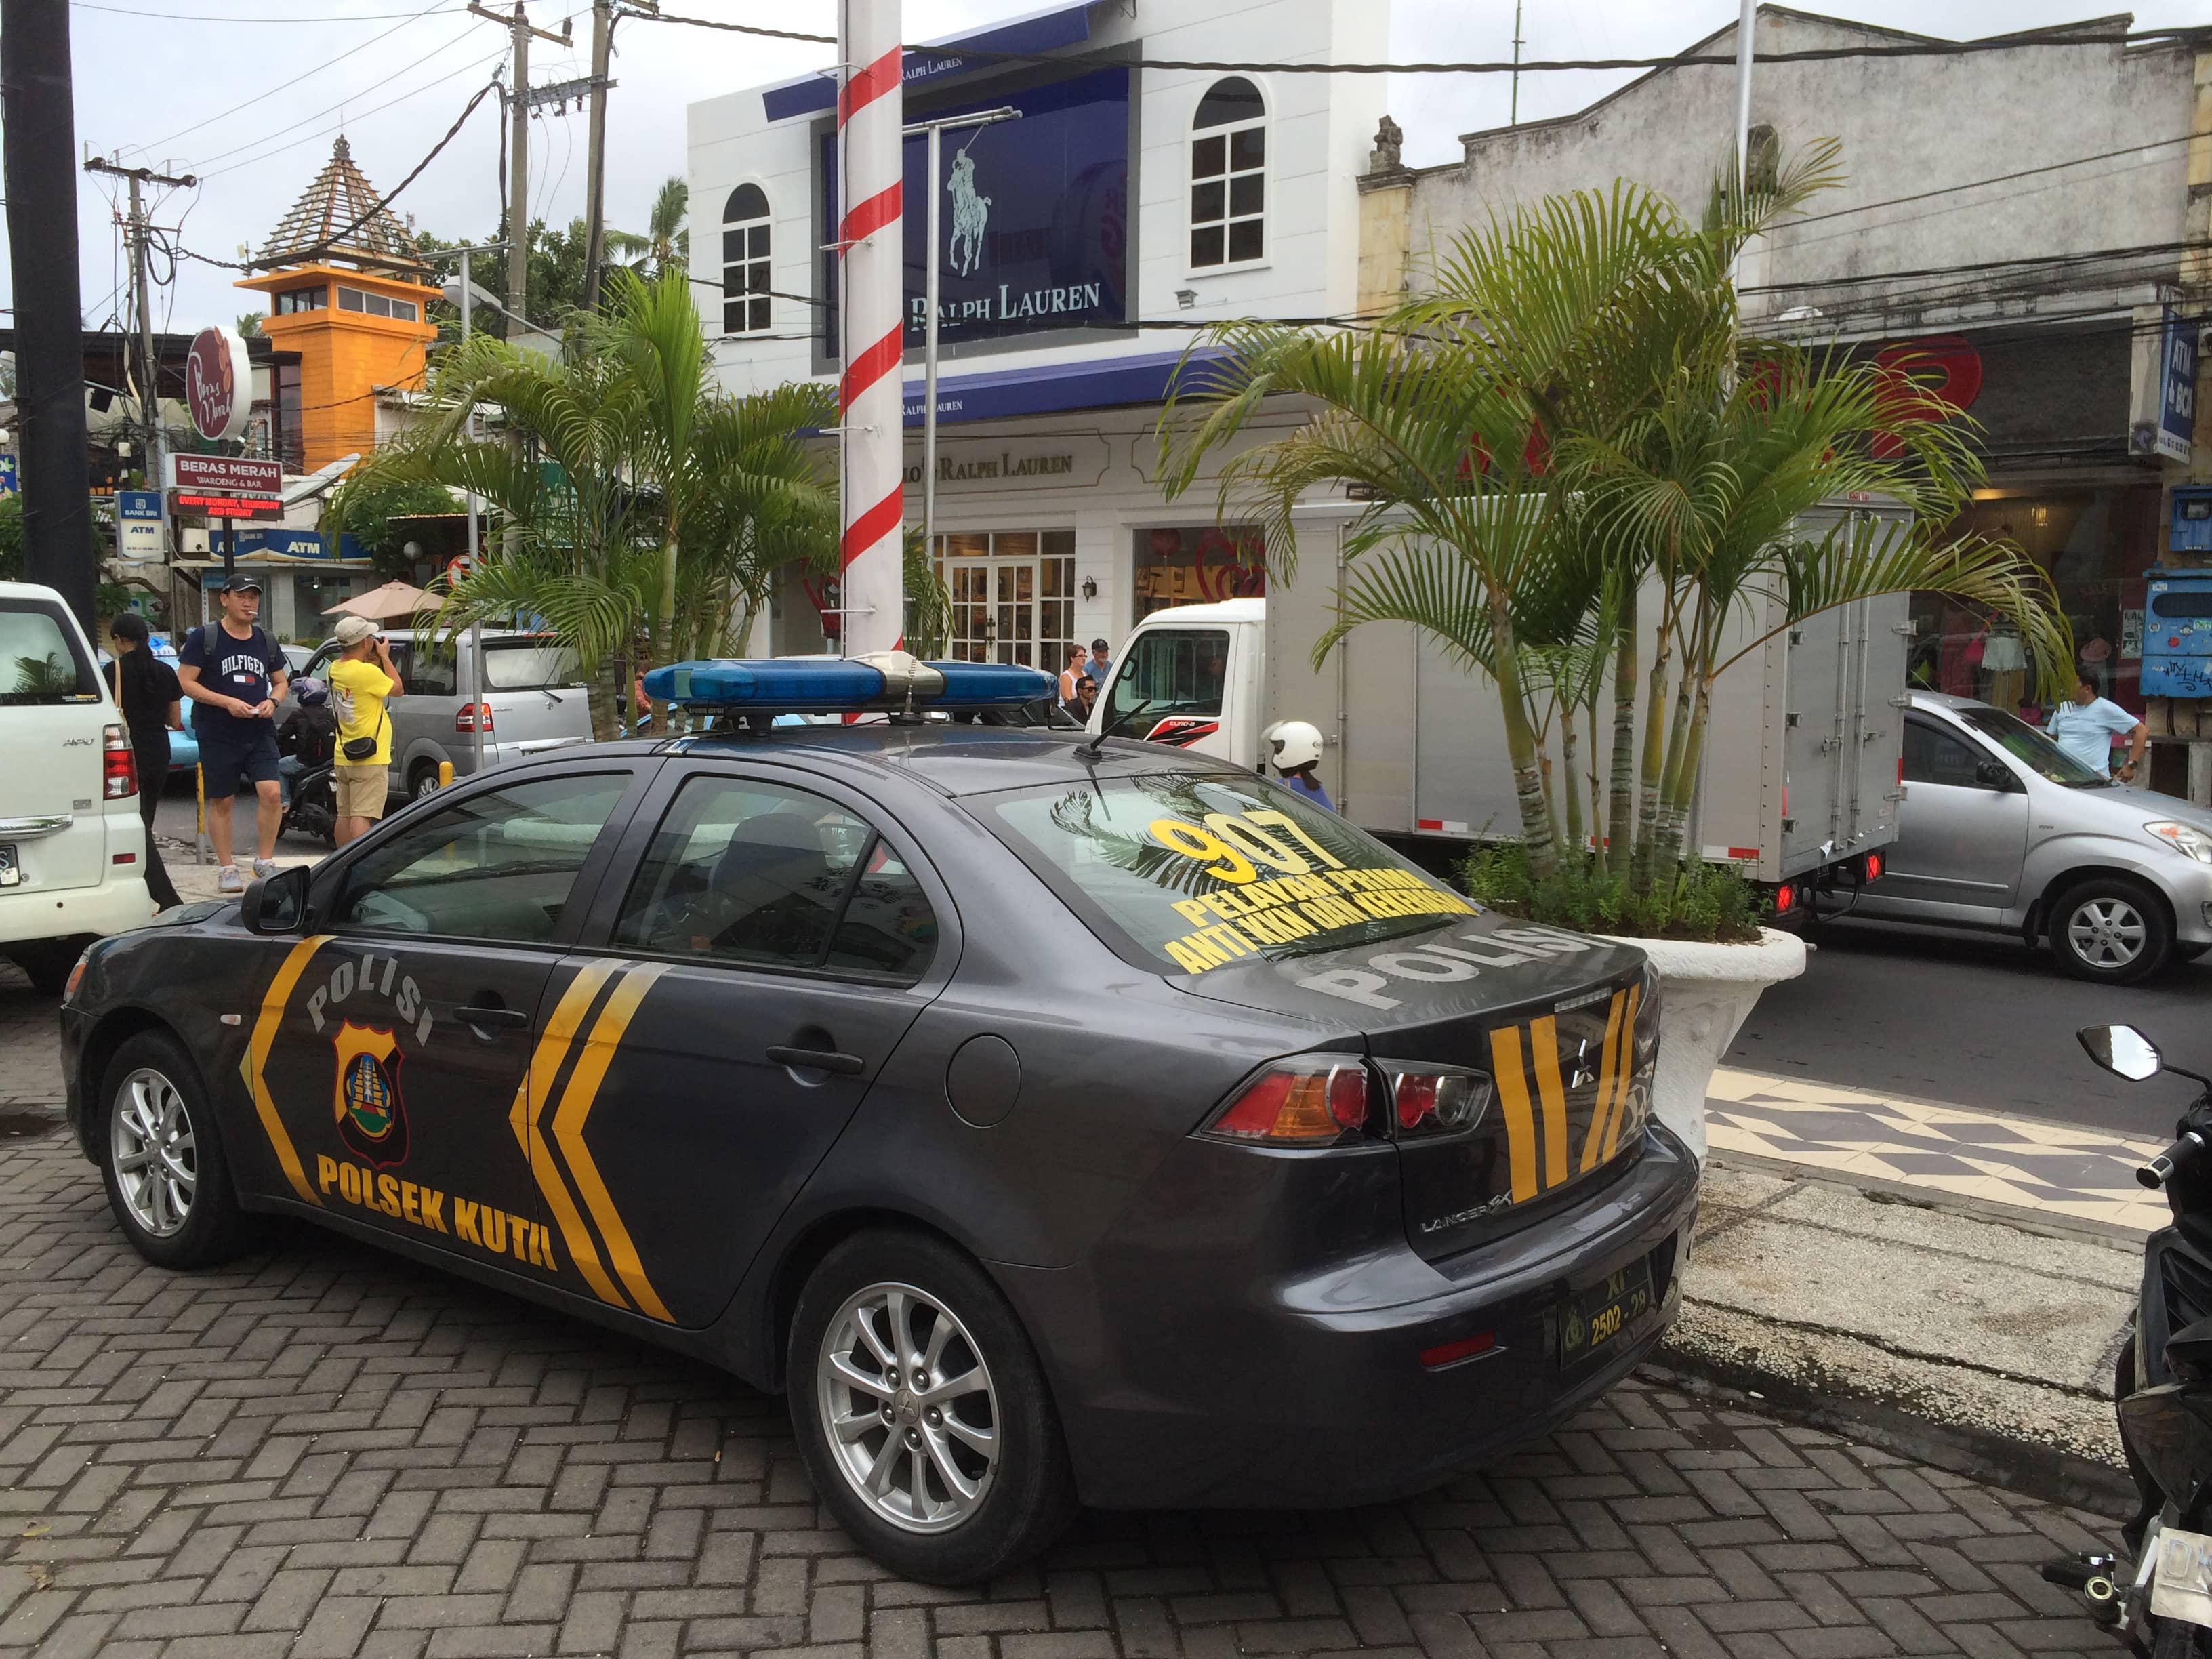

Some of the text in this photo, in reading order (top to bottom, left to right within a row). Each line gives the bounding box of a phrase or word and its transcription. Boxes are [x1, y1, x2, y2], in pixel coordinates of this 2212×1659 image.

[928, 56, 962, 74] LAUREN
[998, 283, 1100, 320] LAUREN
[2172, 337, 2192, 377] ATM
[937, 401, 962, 412] AUREN
[2175, 382, 2193, 420] BCA
[180, 460, 278, 478] BERAS MERAH
[196, 476, 238, 486] WAROENG
[247, 480, 262, 488] BAR
[939, 457, 998, 480] RALPH
[1001, 453, 1073, 478] LAUREN
[178, 495, 205, 505] EVERY
[241, 499, 281, 510] THURSDAY
[207, 506, 253, 516] AND FRIDAY
[130, 526, 155, 534] ATM
[287, 541, 320, 554] ATM
[1149, 811, 1347, 884] 907
[1171, 869, 1433, 928] PELAYAN PRIMA
[1164, 922, 1261, 975] ANTI
[1236, 904, 1319, 945] KKN
[1300, 893, 1372, 930] DAN
[1295, 926, 1617, 1010] POLISI
[306, 954, 434, 1047] POLISI
[316, 1153, 559, 1271] POLSEK KUTA
[1420, 1205, 1488, 1232] LANCER
[1591, 1304, 1621, 1347] 2502
